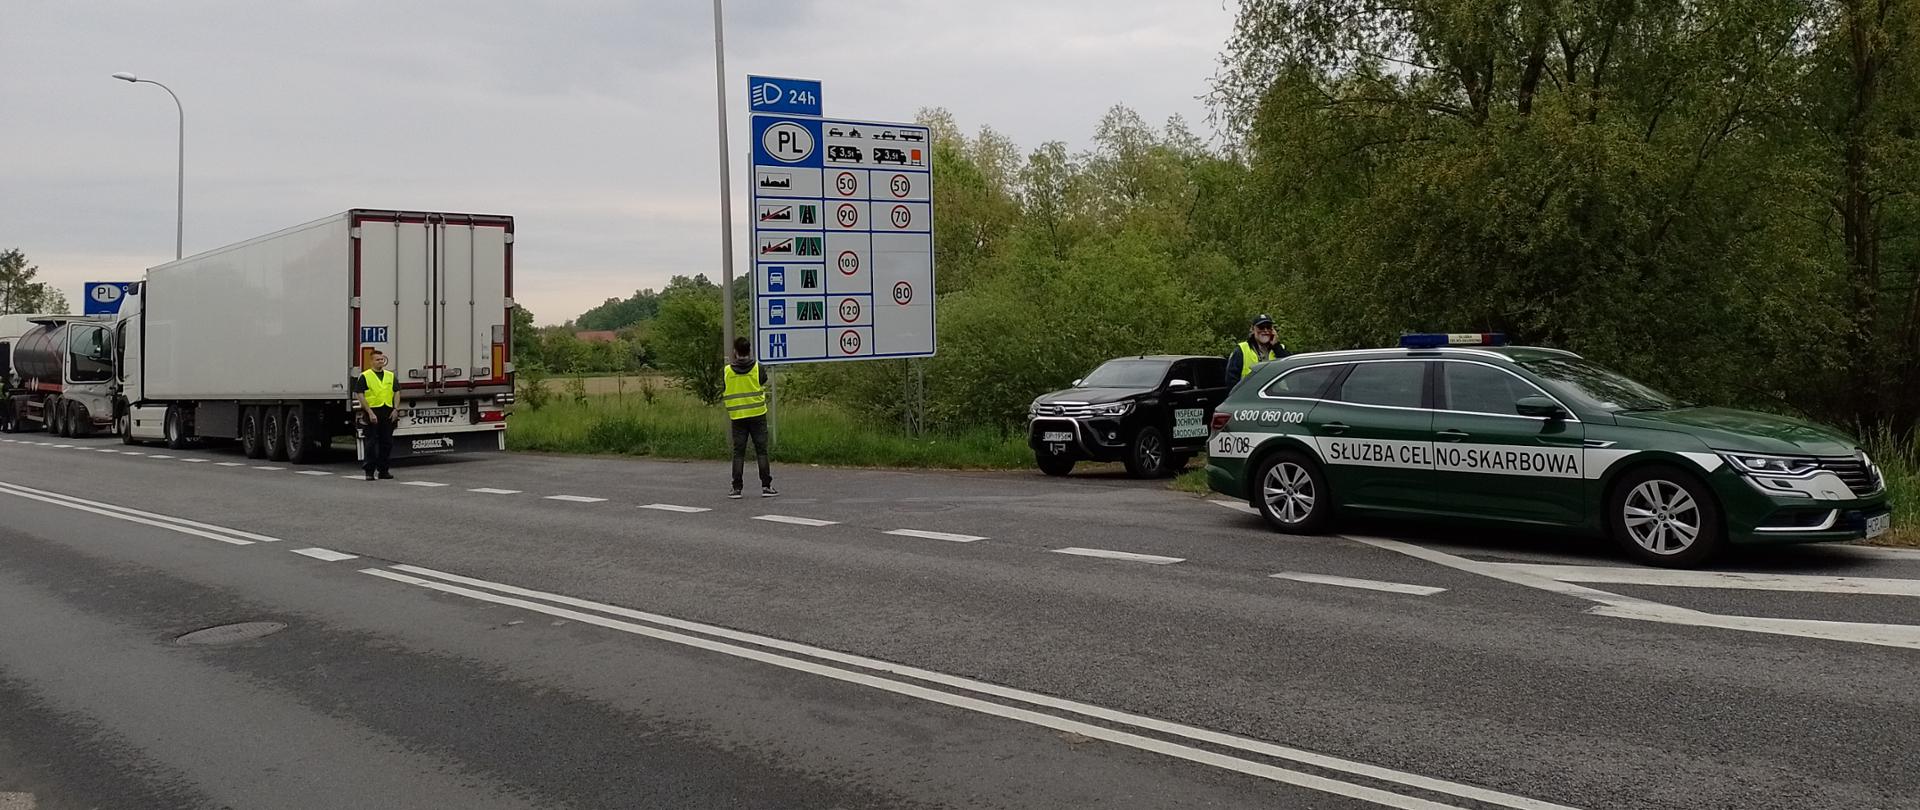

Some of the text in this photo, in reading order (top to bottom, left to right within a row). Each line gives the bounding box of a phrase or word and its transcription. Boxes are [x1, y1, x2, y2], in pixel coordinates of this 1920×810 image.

[788, 90, 816, 105] 24h
[778, 131, 803, 153] PL
[839, 177, 853, 190] 50
[893, 180, 907, 193] 50
[840, 209, 855, 222] 90
[895, 211, 908, 222] 70
[841, 257, 856, 268] 100
[97, 287, 115, 299] PL
[895, 287, 910, 299] 80
[842, 305, 857, 316] 120
[363, 327, 386, 342] TIR
[842, 336, 858, 348] 140
[411, 416, 454, 425] SCHMITZ
[1239, 410, 1304, 424] 800 060 000
[1218, 437, 1250, 455] 16/08
[1330, 441, 1395, 463] SŁUŻBA
